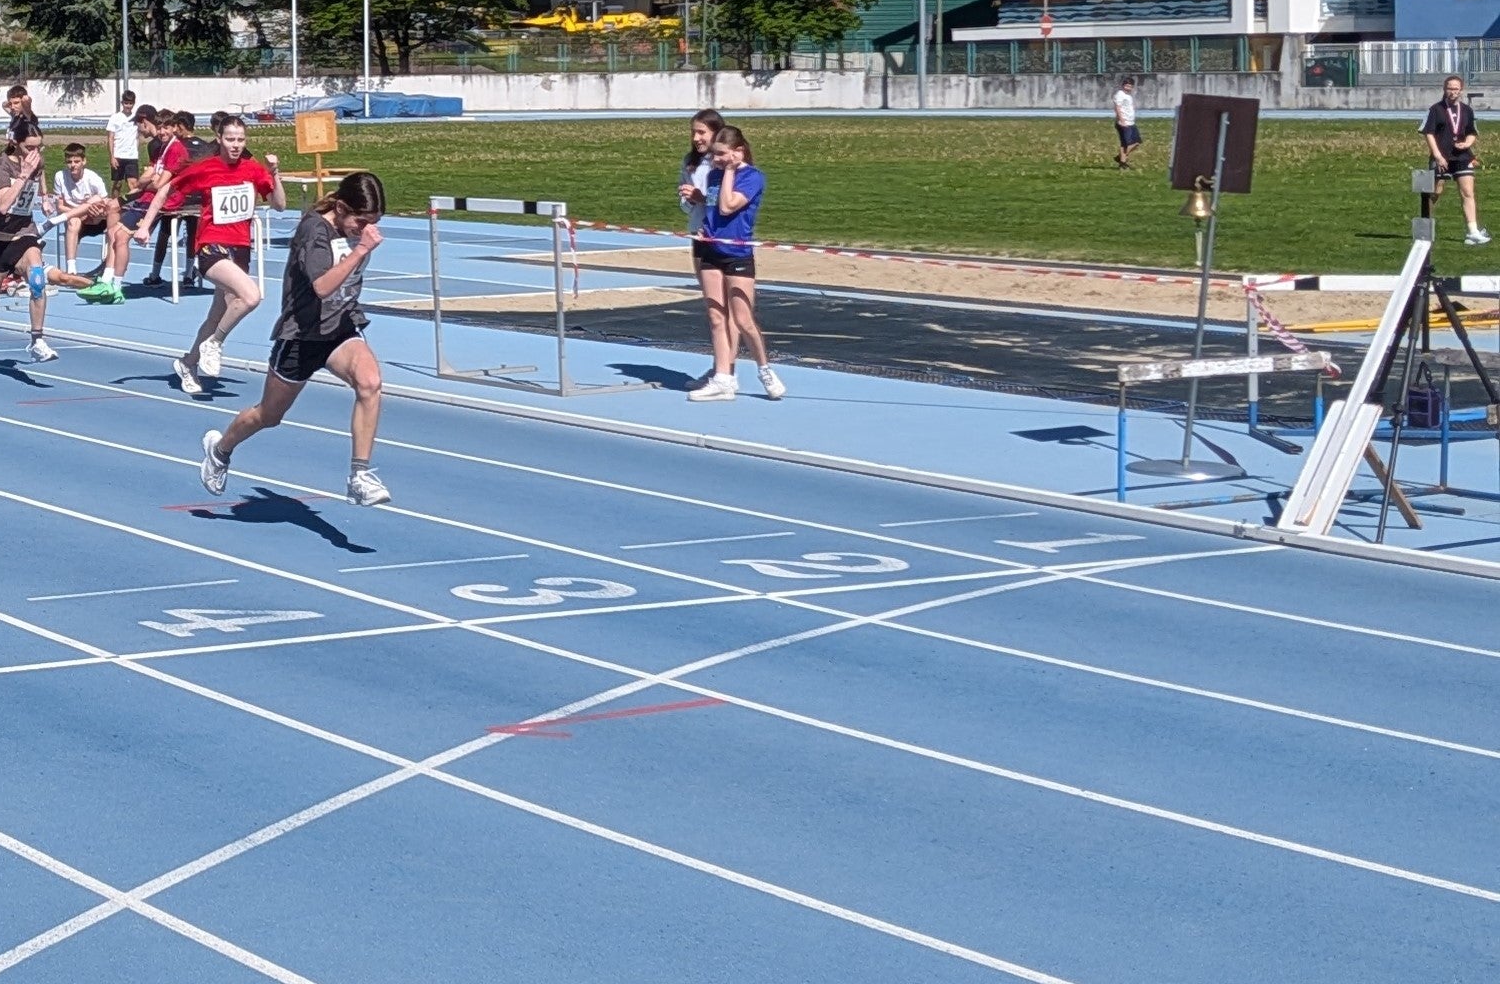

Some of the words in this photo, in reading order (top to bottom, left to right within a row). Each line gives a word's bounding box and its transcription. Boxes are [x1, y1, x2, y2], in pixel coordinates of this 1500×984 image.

[219, 194, 249, 215] 400
[995, 533, 1145, 553] 1
[721, 552, 909, 579] 2
[451, 577, 636, 605] 3
[138, 608, 324, 637] 4
